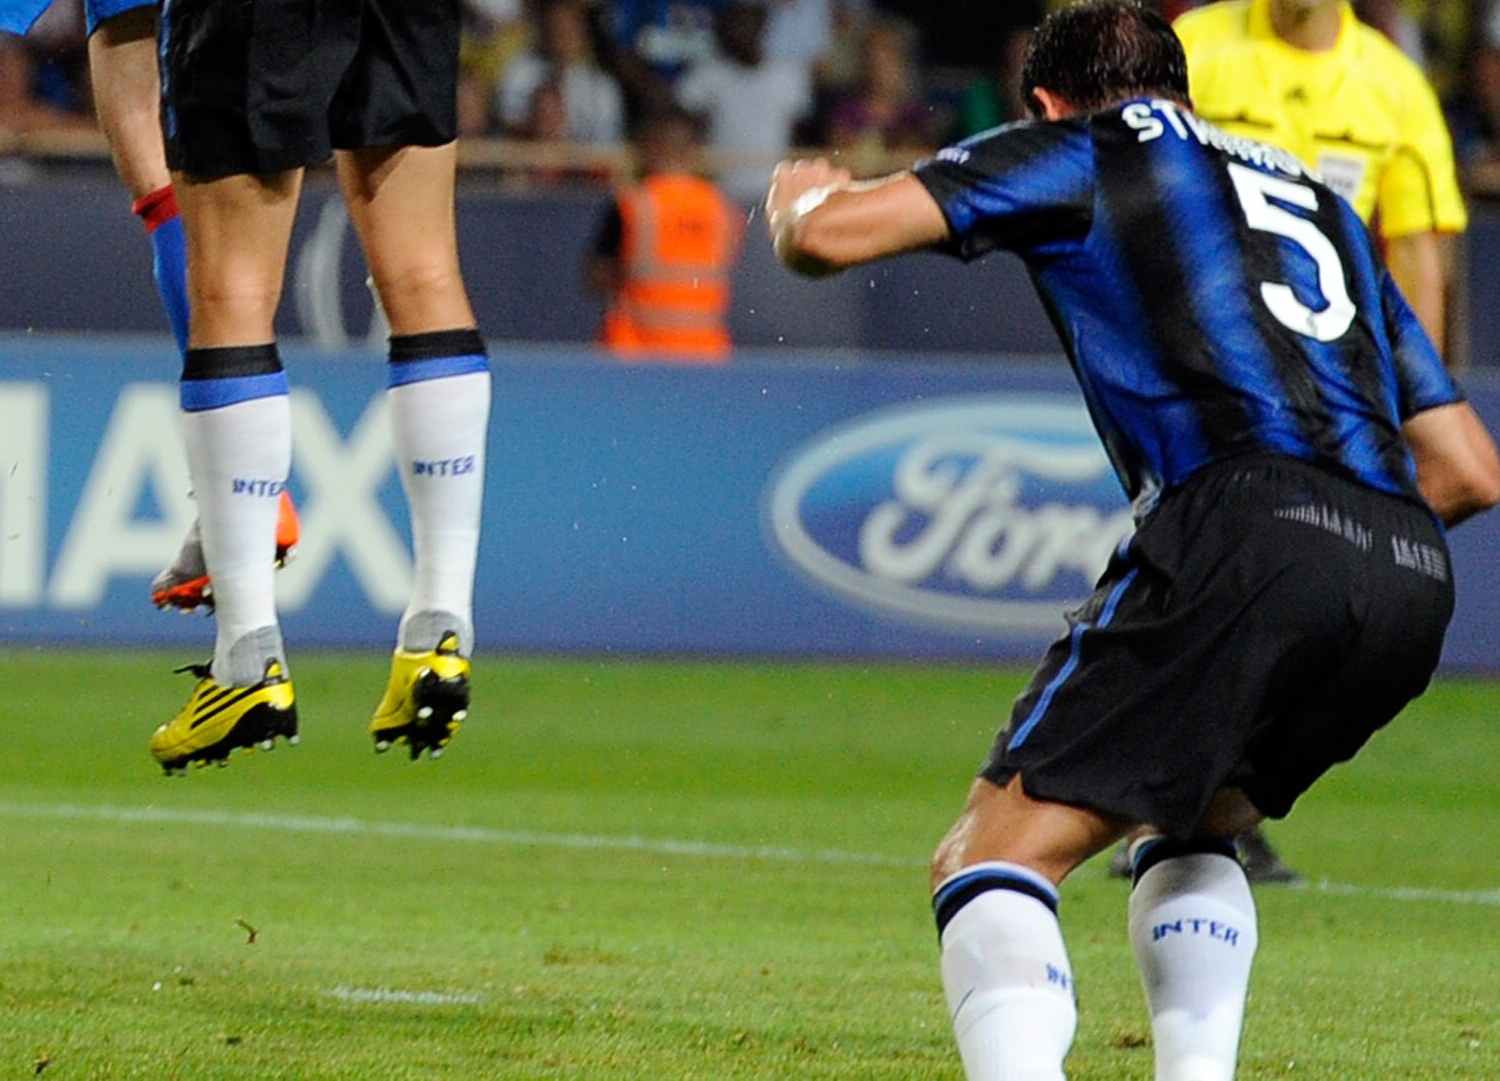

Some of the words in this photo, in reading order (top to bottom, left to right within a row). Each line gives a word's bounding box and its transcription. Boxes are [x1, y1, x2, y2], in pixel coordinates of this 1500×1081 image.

[1226, 161, 1357, 342] 5
[411, 454, 475, 477] INTER
[858, 427, 1138, 594] For
[1152, 917, 1240, 947] INTER
